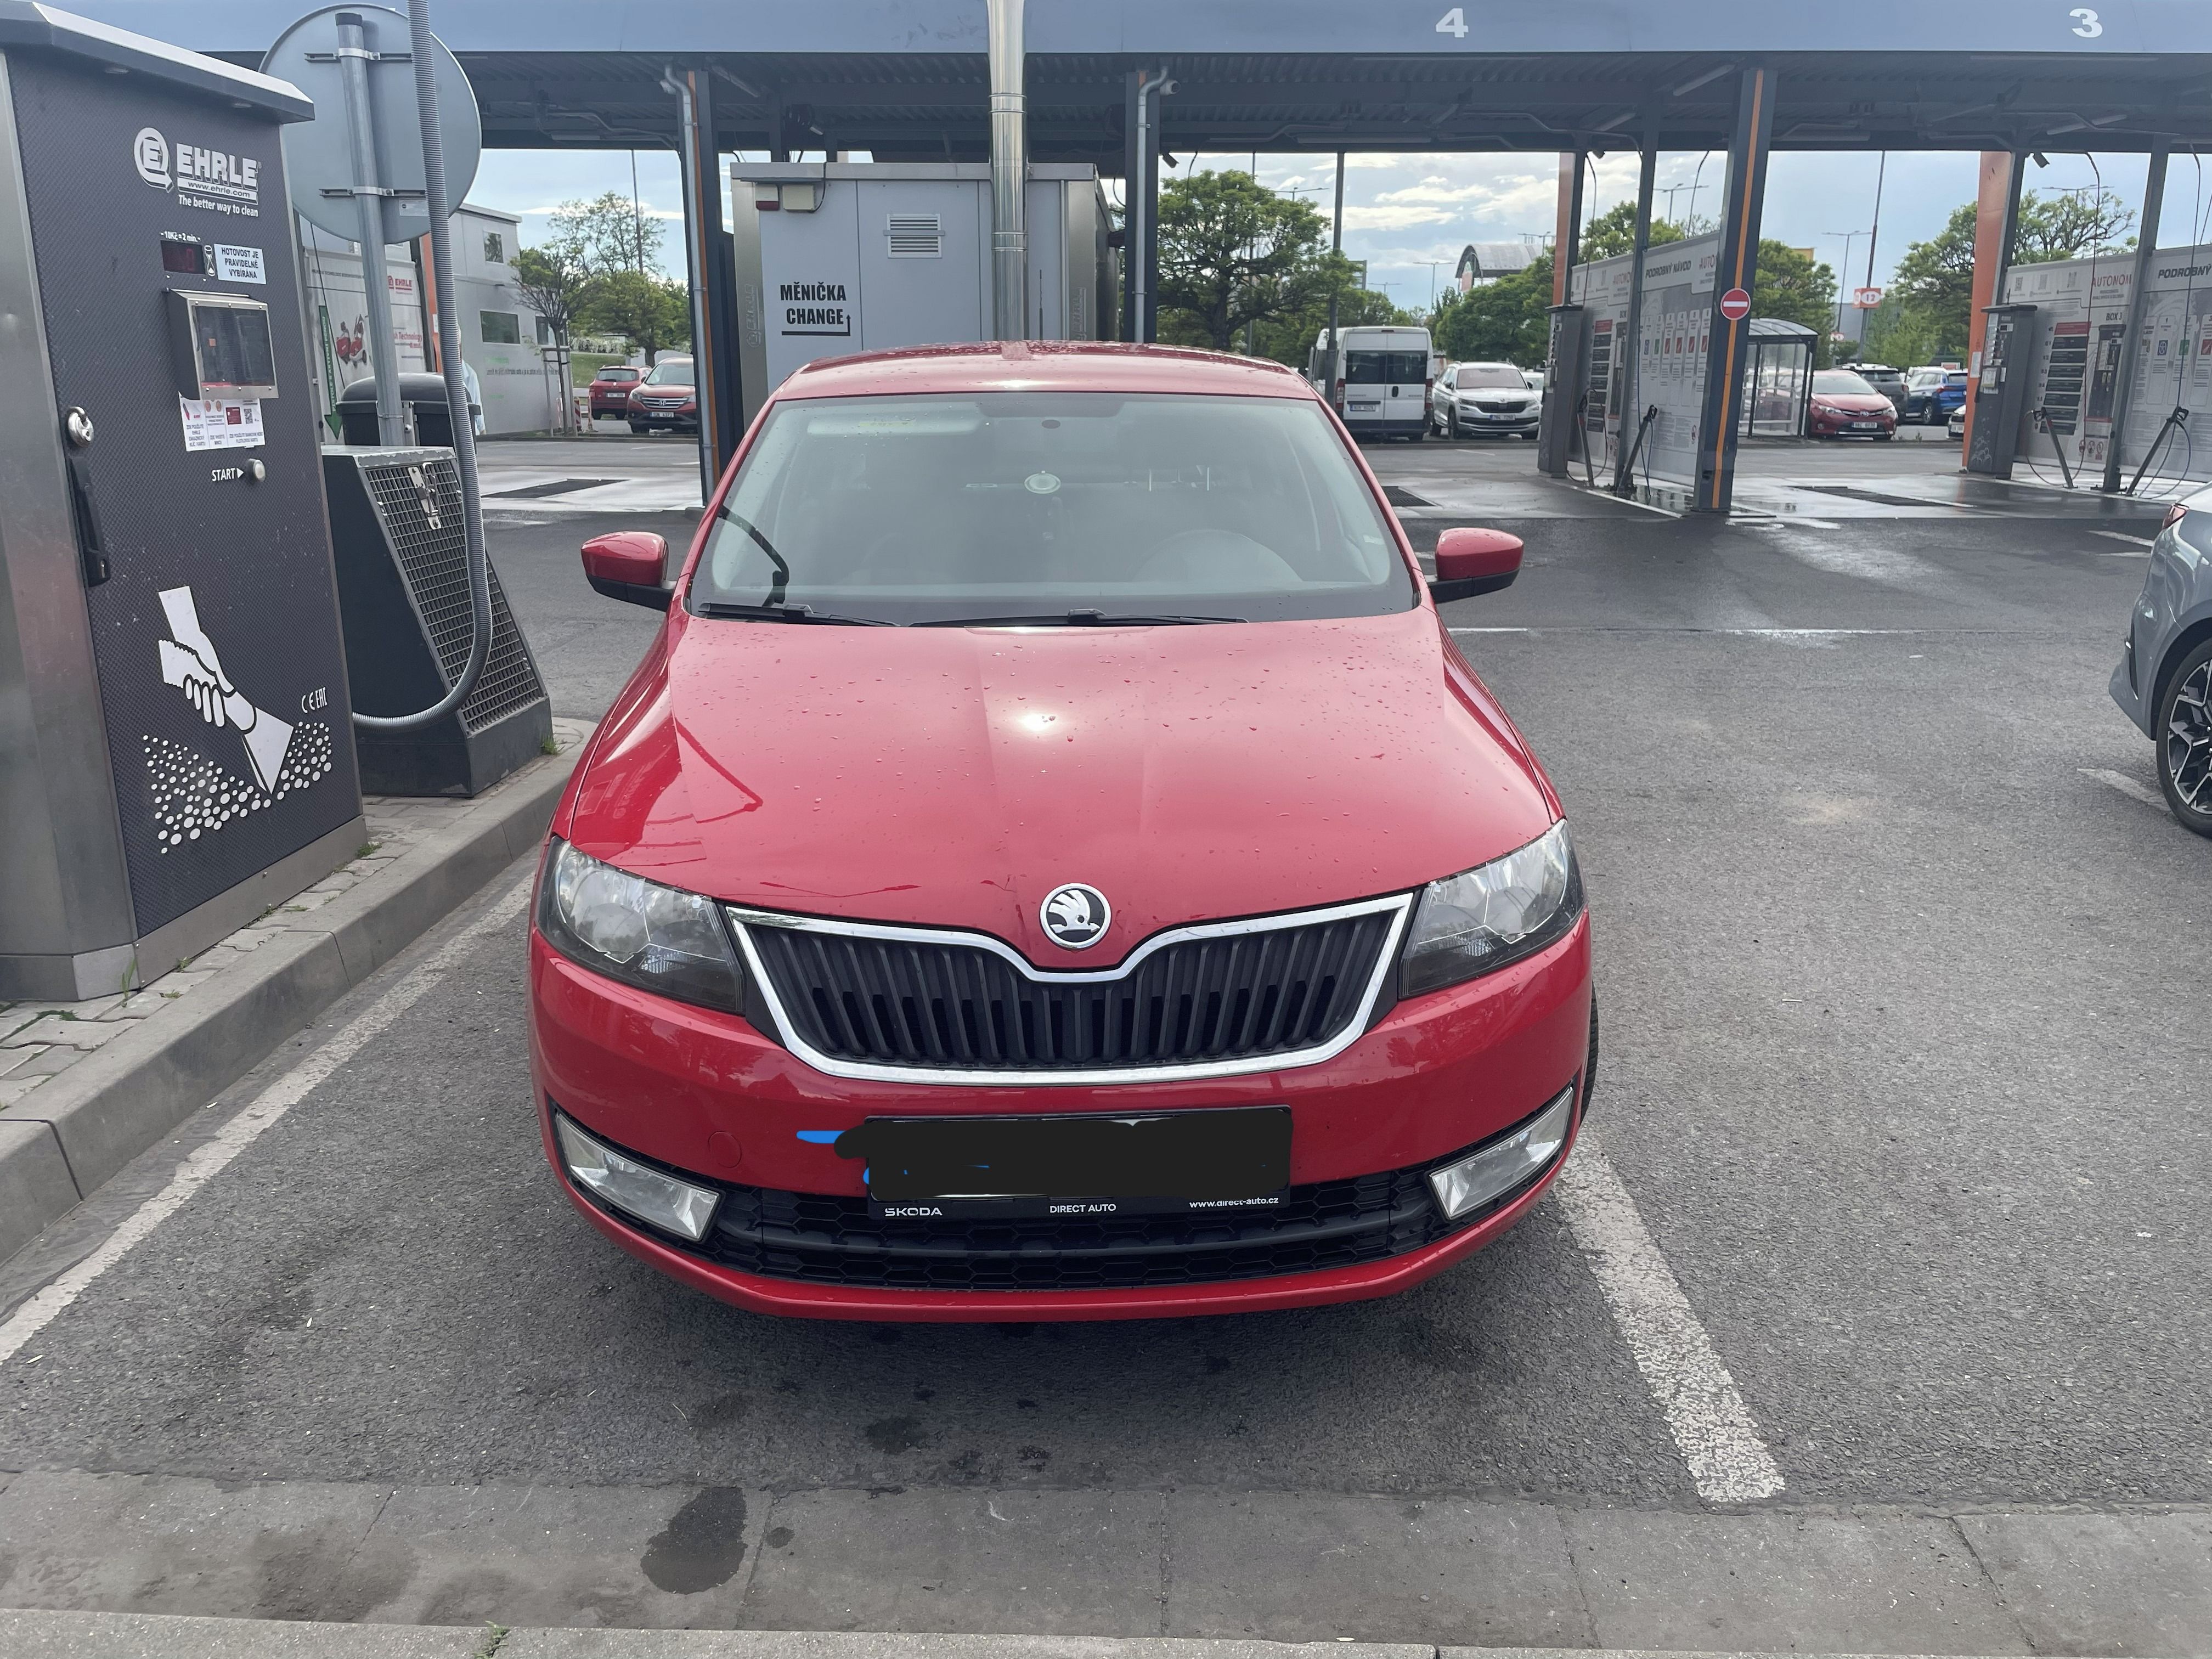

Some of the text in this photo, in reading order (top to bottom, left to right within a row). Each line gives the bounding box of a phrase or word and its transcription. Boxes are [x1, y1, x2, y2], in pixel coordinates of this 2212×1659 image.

[1436, 8, 1469, 38] 4
[2069, 8, 2103, 38] 3
[177, 143, 258, 191] EHRLE
[188, 181, 251, 199] www.ehrle.com
[178, 194, 259, 217] The better way to clean
[221, 247, 251, 258] HOTOVOST
[780, 281, 847, 301] MĚNIČKA
[786, 308, 844, 325] CHANGE
[212, 467, 235, 482] START
[1049, 1204, 1117, 1213] DIRECT AUTO
